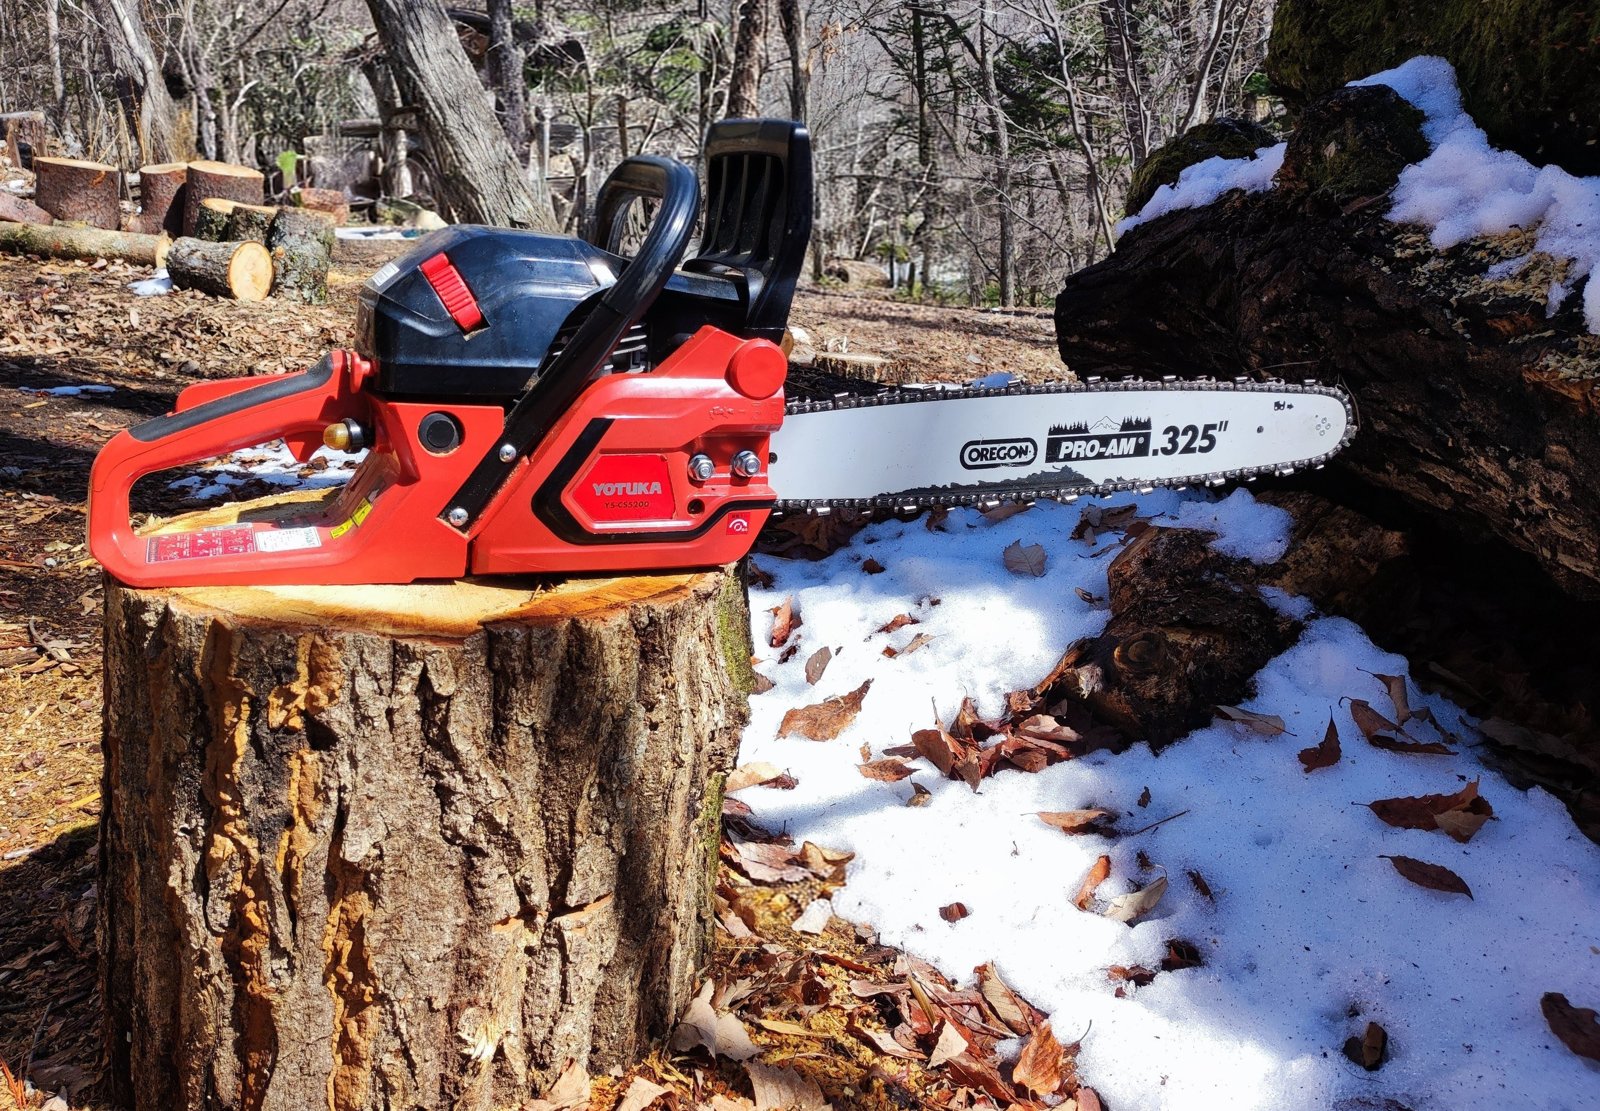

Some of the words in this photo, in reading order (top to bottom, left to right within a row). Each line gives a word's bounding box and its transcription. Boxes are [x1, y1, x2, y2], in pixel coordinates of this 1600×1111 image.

[967, 444, 1029, 463] OREGON
[1058, 437, 1137, 460] PRO-AM
[592, 481, 662, 497] YOTUKA
[604, 501, 650, 509] YS-CS5200
